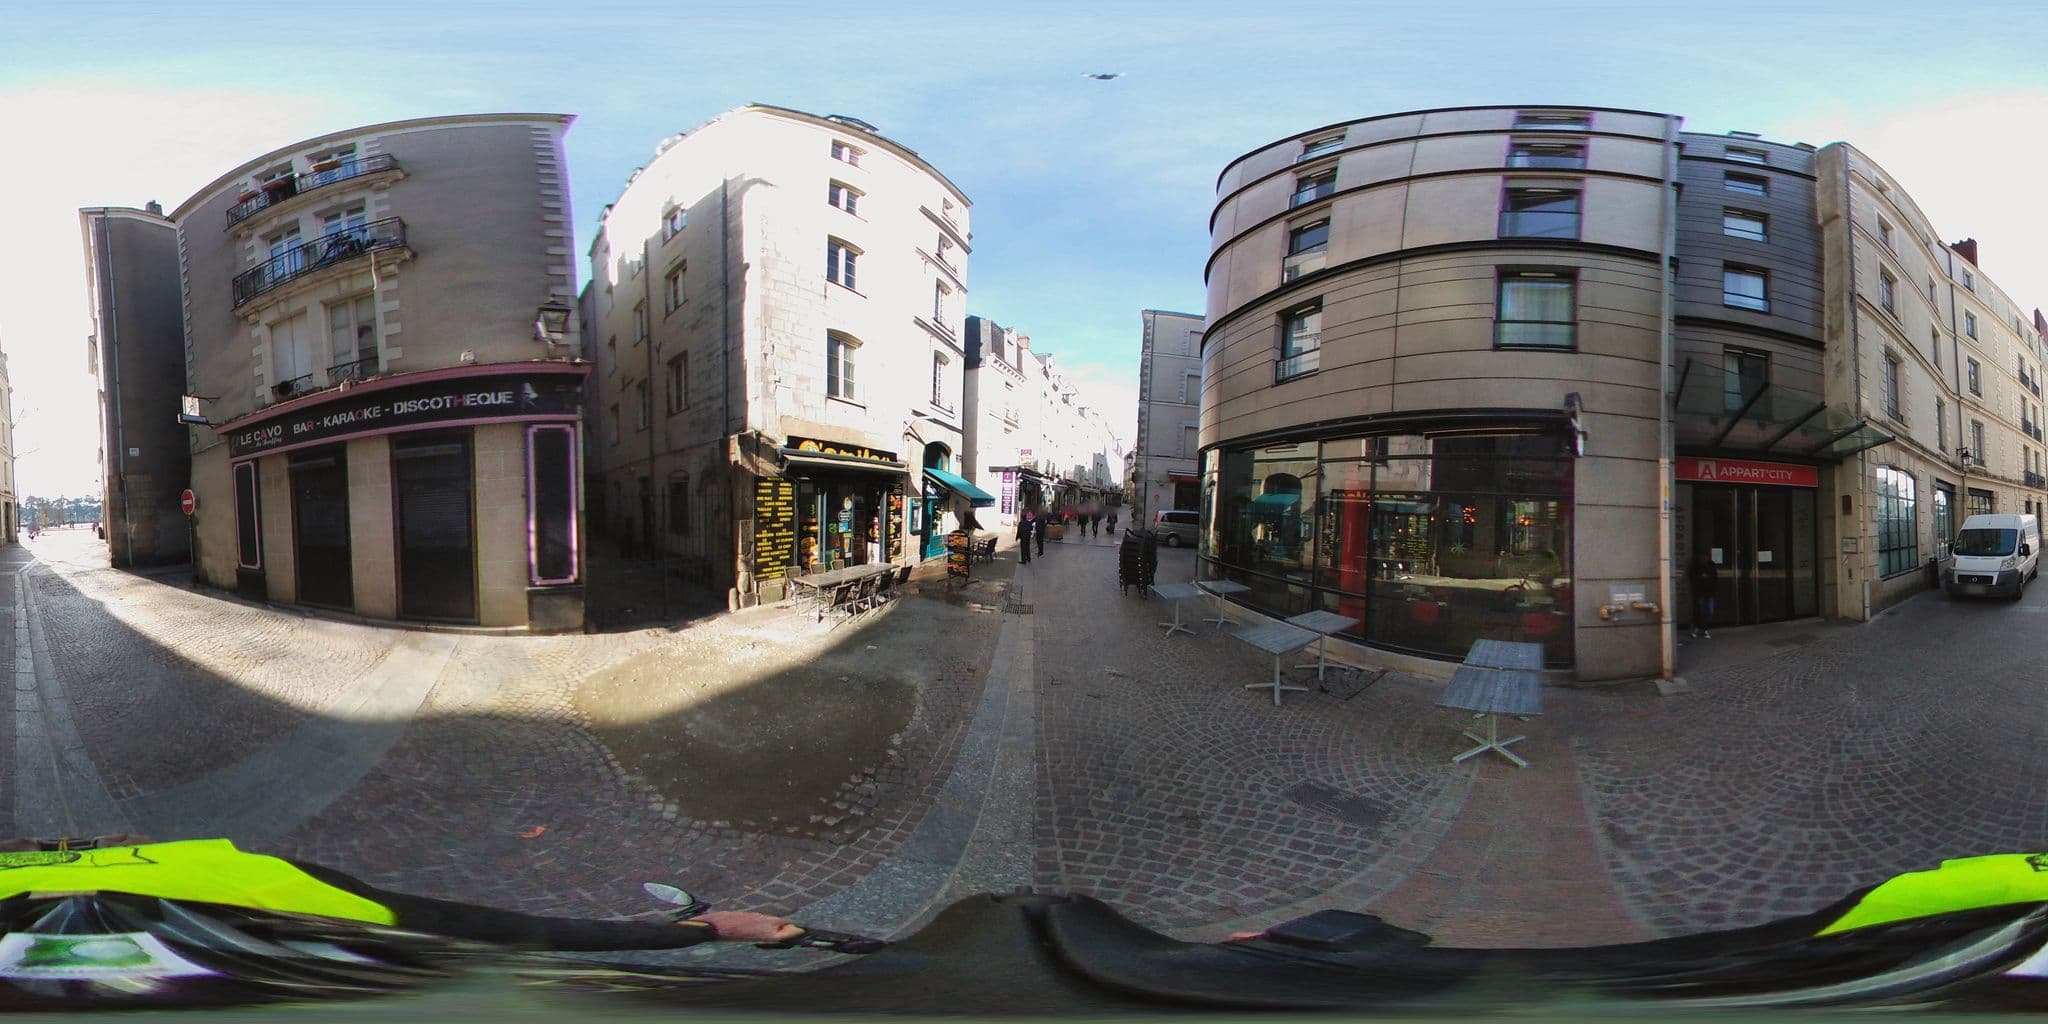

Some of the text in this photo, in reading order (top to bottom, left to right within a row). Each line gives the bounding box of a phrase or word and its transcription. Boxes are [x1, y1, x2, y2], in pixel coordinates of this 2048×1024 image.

[293, 420, 314, 434] BAR
[323, 406, 381, 428] KARAOKE
[393, 390, 514, 415] DISCOTHEQUE
[240, 425, 282, 446] LE CAVO
[1698, 461, 1793, 480] A APPART'CITY
